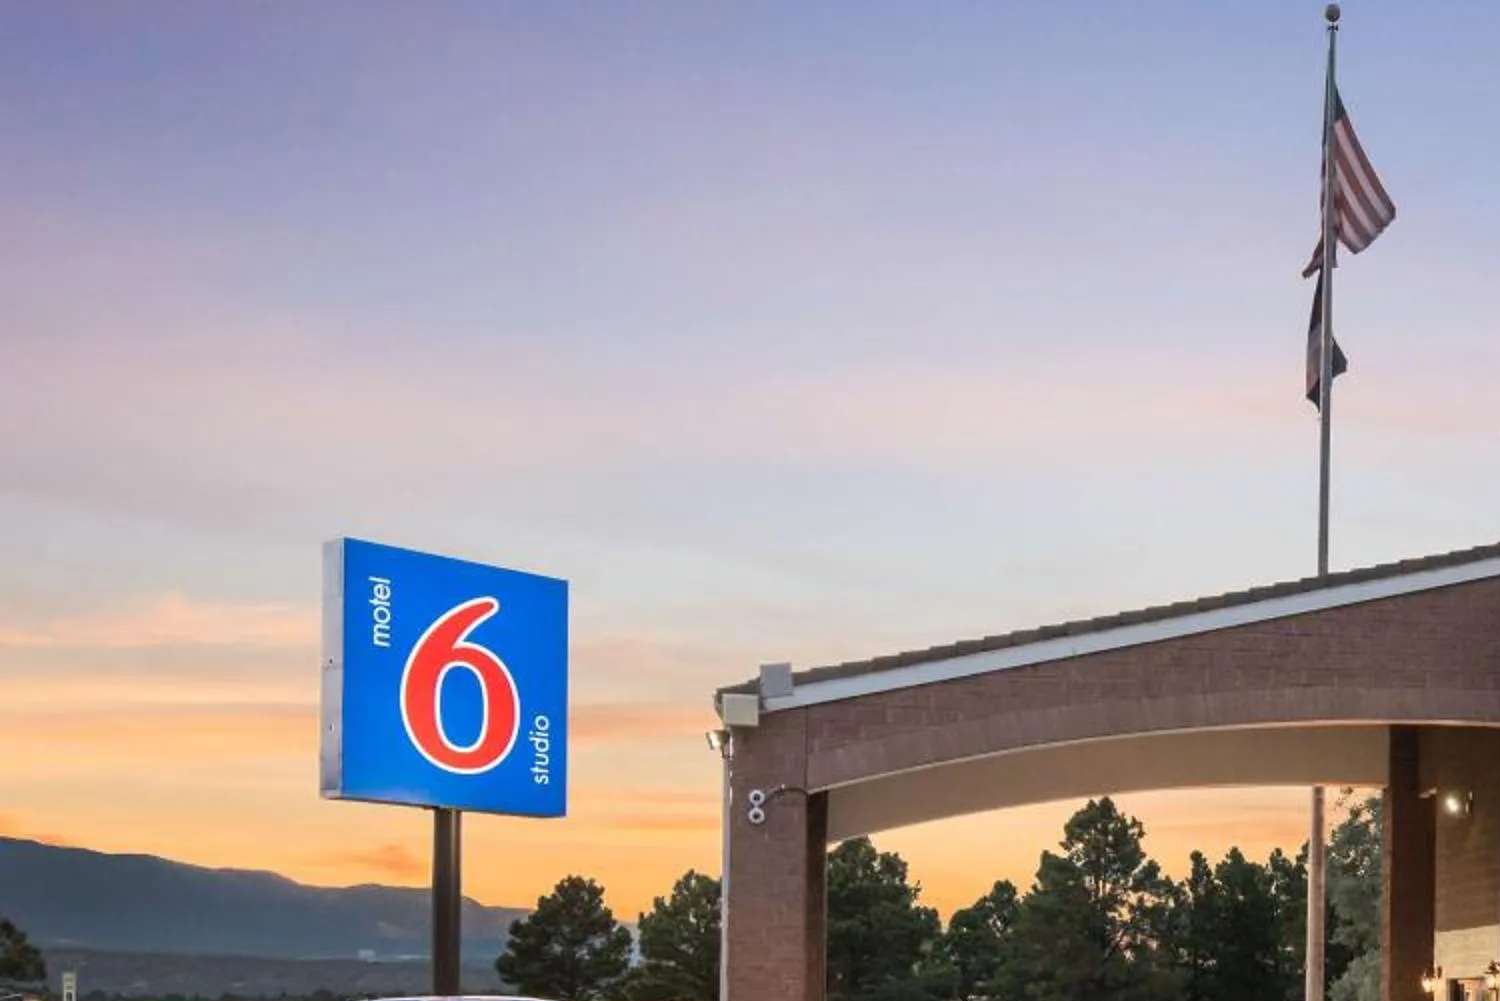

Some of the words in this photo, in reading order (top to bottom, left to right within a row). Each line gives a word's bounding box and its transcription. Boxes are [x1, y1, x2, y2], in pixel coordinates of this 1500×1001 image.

[368, 576, 391, 647] motel
[400, 596, 521, 775] 6
[529, 715, 550, 785] studio
